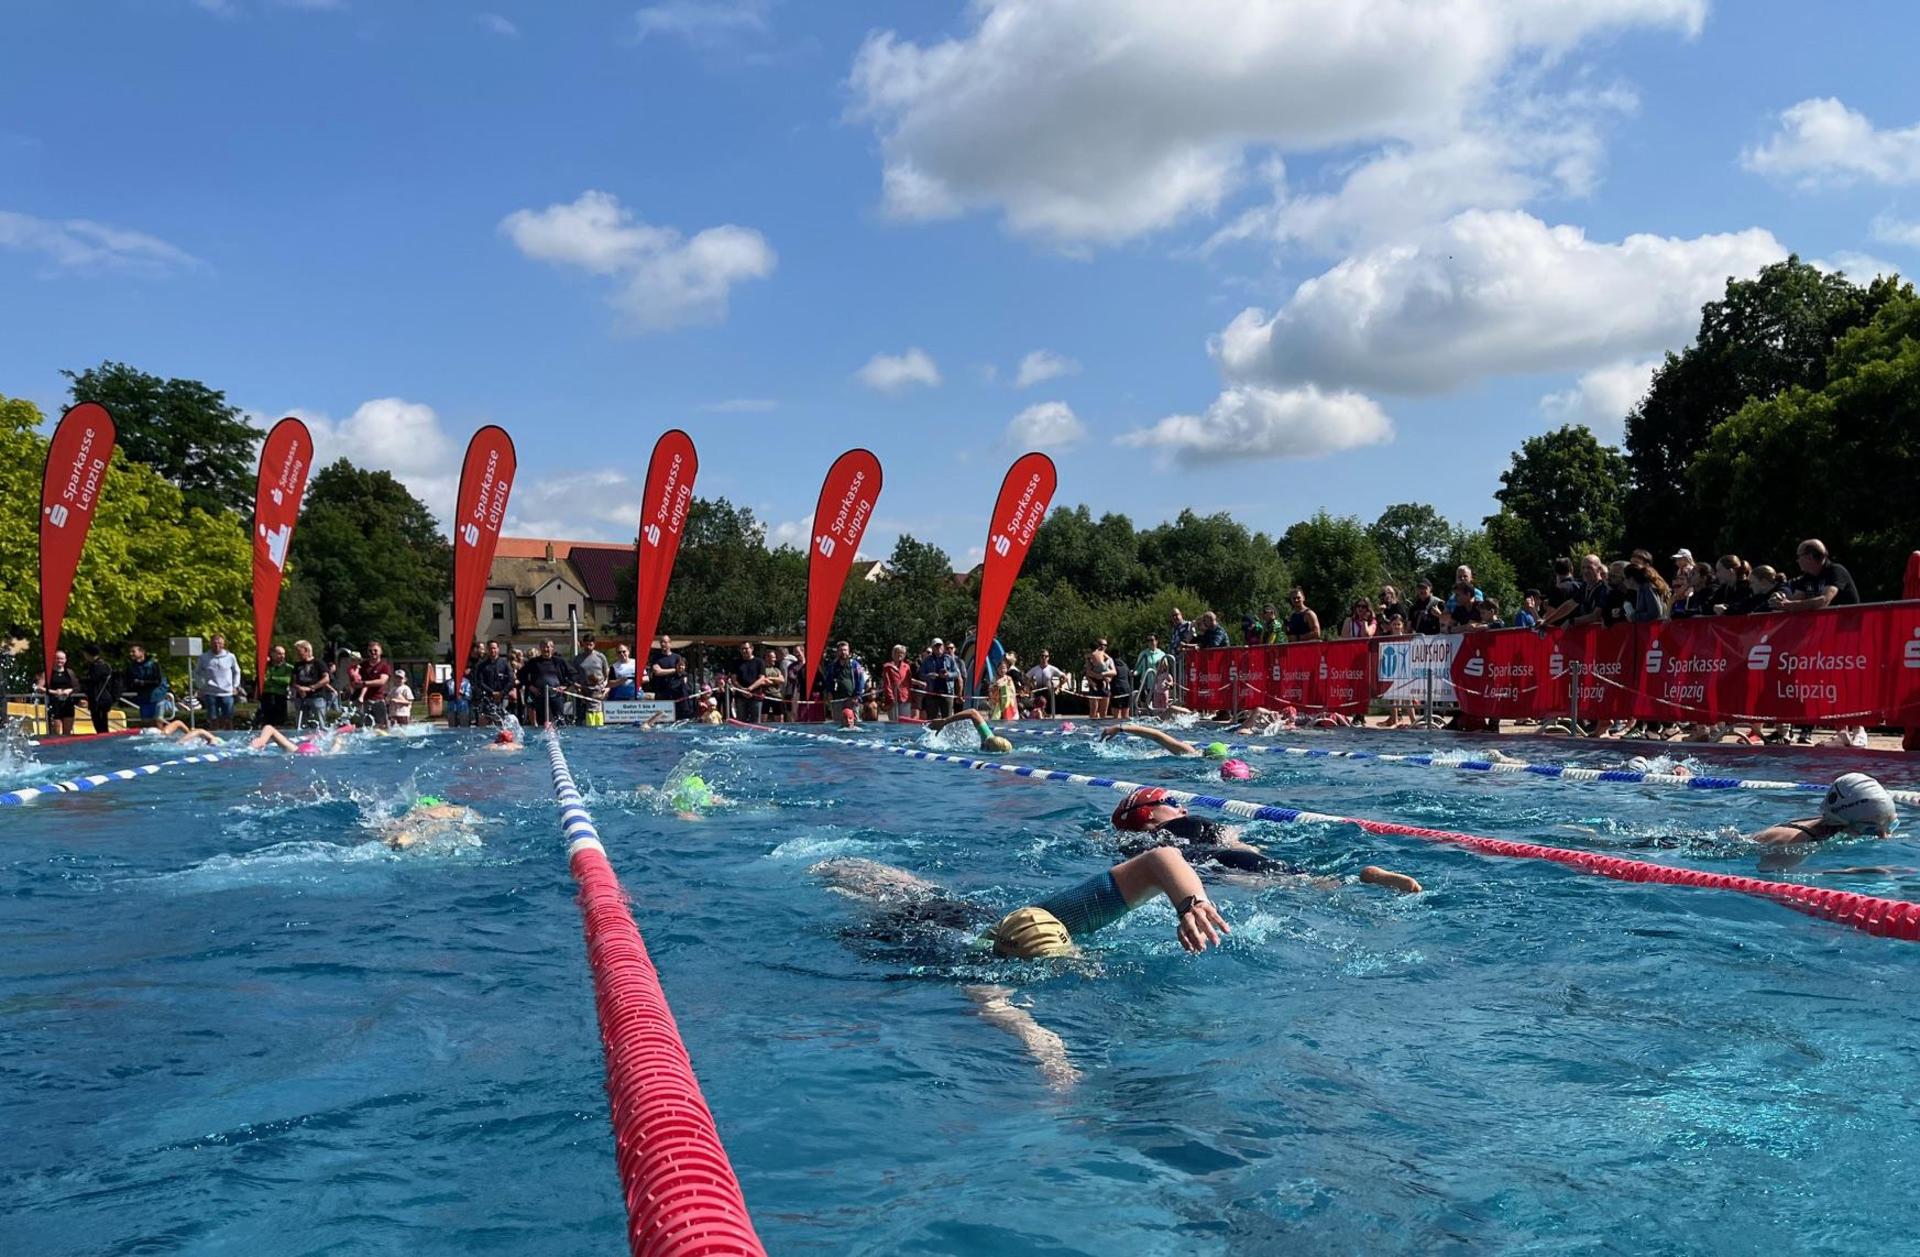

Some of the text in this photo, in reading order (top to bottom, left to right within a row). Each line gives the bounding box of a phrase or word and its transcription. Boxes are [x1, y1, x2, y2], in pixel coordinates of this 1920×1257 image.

[63, 428, 96, 501] Sparkasse
[76, 459, 105, 511] Leipzig
[279, 440, 299, 487] Sparkasse
[286, 460, 302, 494] Leipzig
[473, 449, 499, 522] Sparkasse
[486, 480, 508, 532] Leipzig
[657, 454, 682, 523] Sparkasse
[668, 484, 691, 534] Leipzig
[831, 471, 865, 535] Sparkasse
[1007, 473, 1041, 535] Sparkasse
[843, 499, 871, 546] Leipzig
[1018, 501, 1045, 546] Leipzig
[1487, 663, 1535, 681] Sparkasse
[1667, 655, 1728, 674] Sparkasse
[1777, 651, 1868, 674] Sparkasse
[1664, 682, 1705, 703] Leipzig
[1777, 680, 1838, 703] Leipzig
